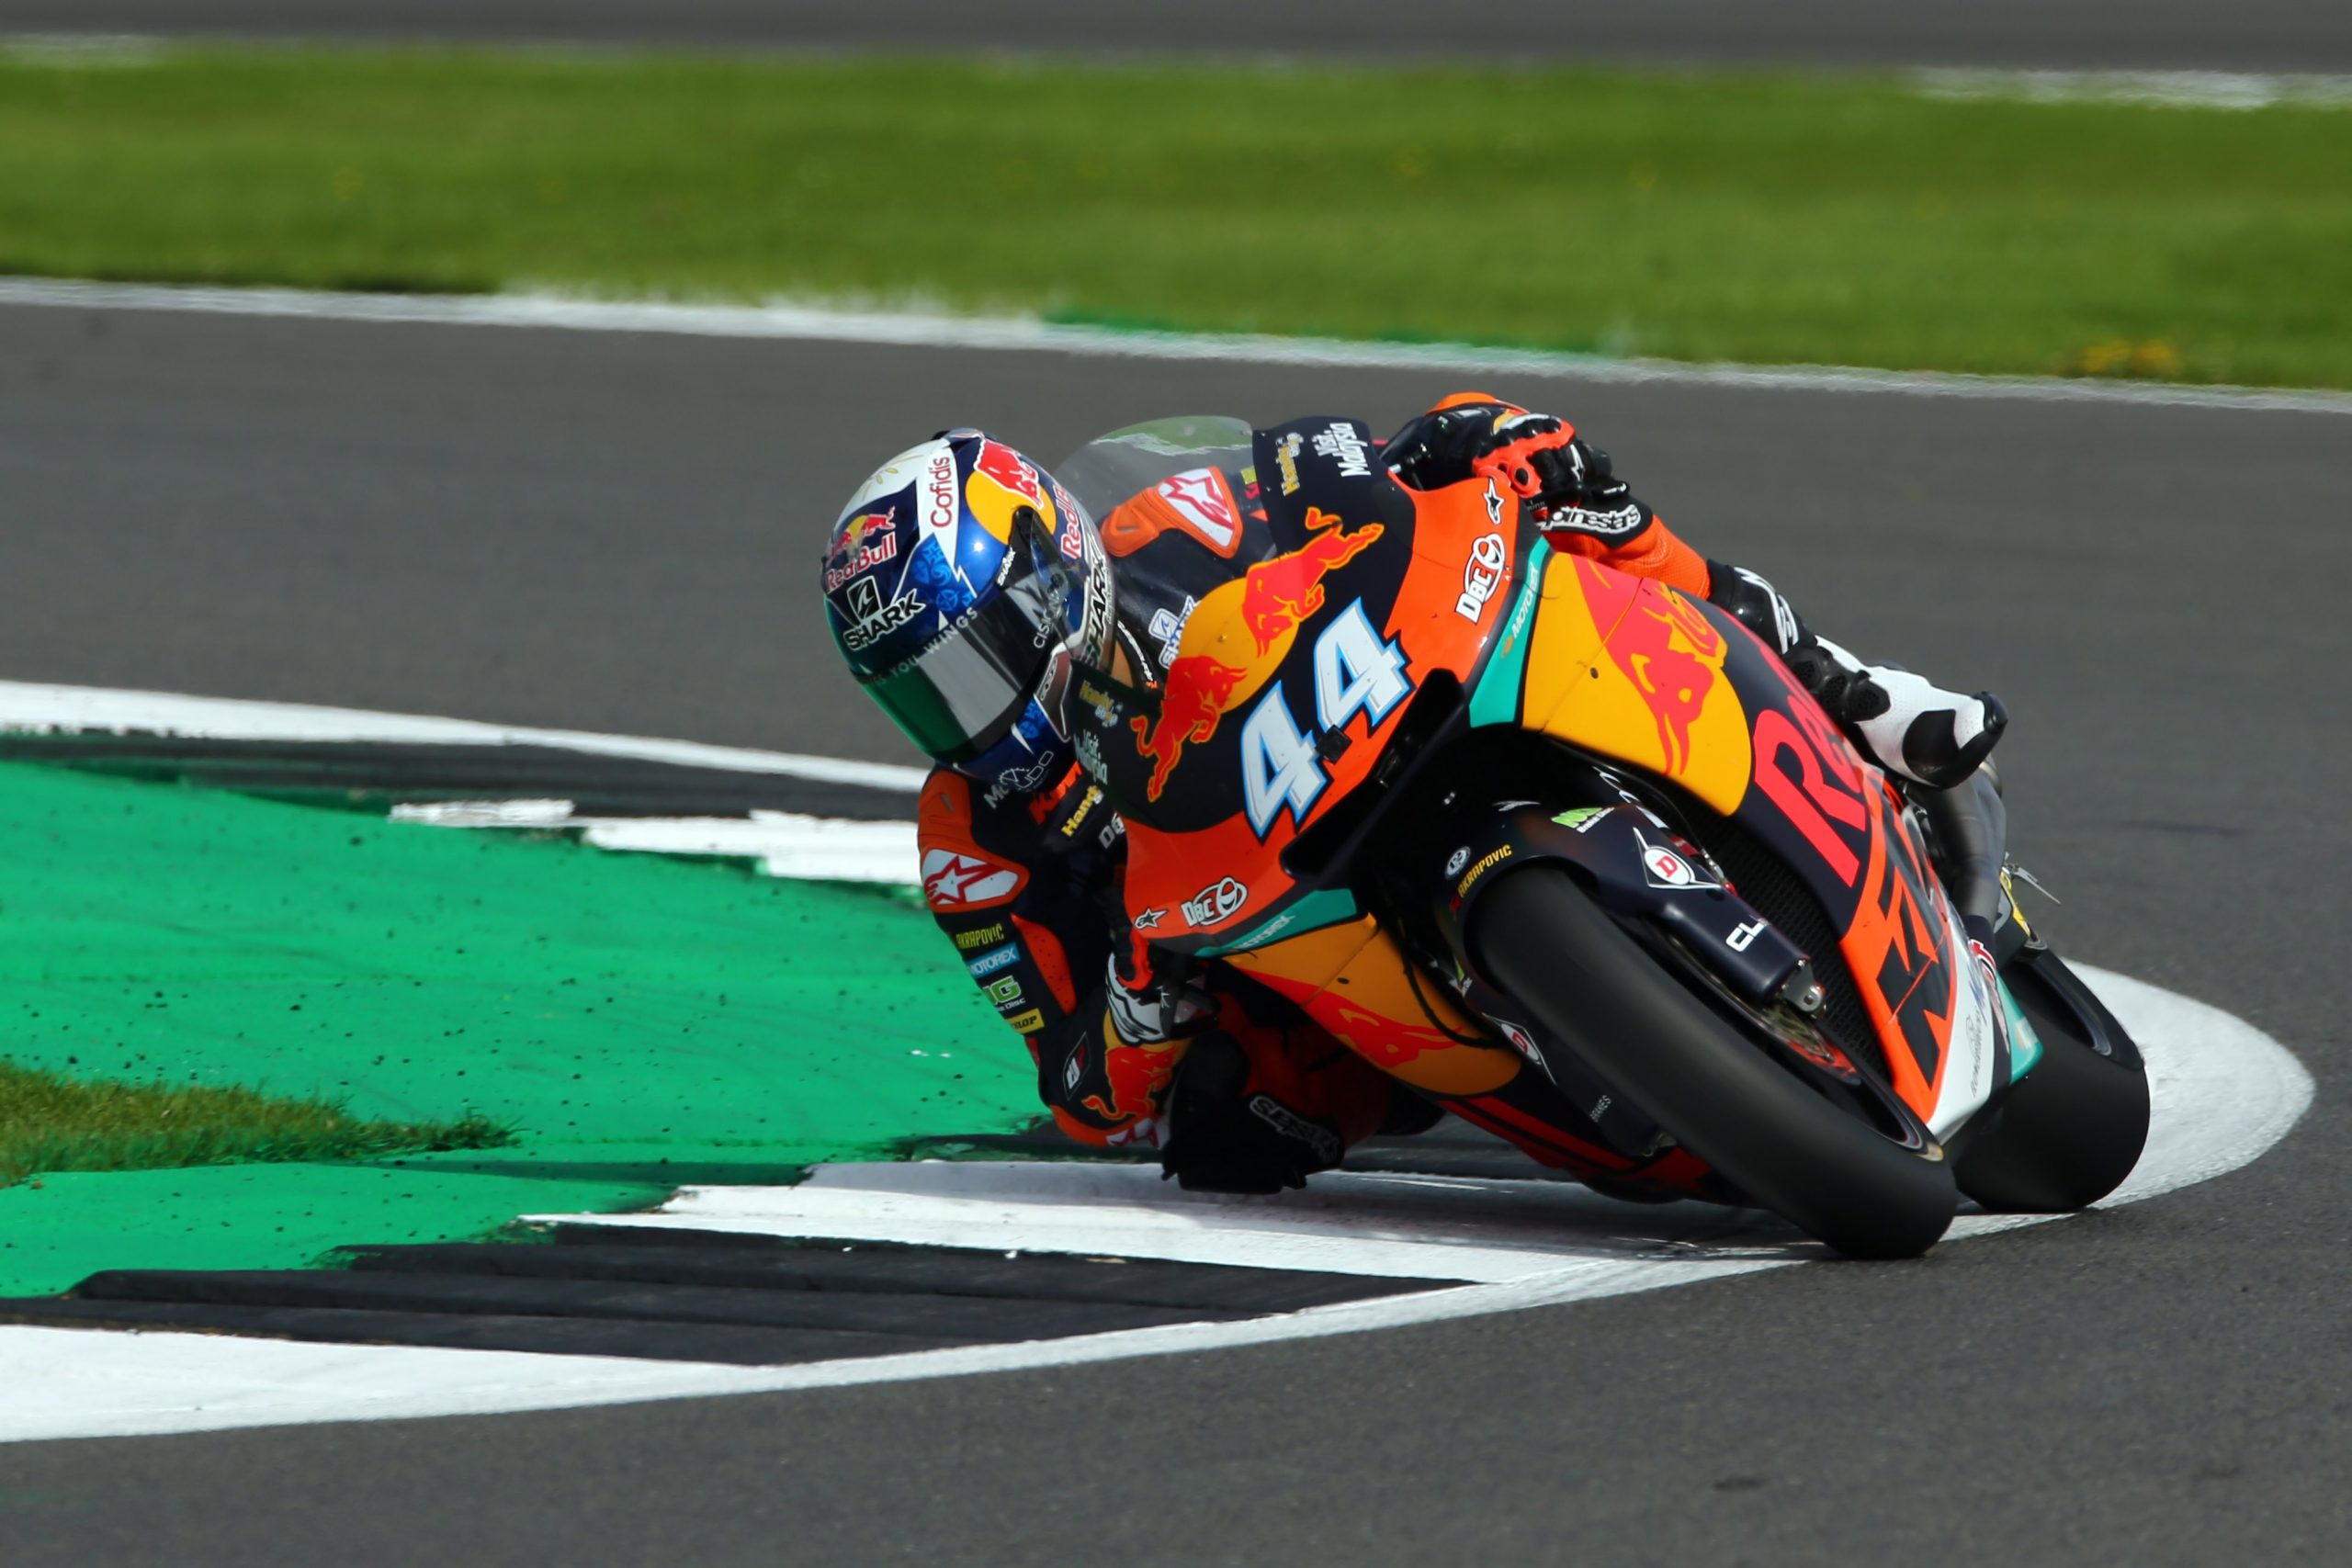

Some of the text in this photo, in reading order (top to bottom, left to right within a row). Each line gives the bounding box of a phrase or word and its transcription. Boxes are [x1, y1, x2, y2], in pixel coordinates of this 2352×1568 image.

[931, 456, 952, 527] Cofidis
[857, 530, 897, 573] Bull
[997, 548, 1017, 587] SHARK
[842, 588, 926, 651] SHARK
[1455, 567, 1494, 625] DBC
[923, 606, 978, 654] WINGS
[1241, 595, 1410, 838] 44
[1061, 785, 1100, 837] Hand
[1099, 816, 1125, 849] DB
[1657, 855, 1679, 878] D
[1181, 897, 1216, 927] DBC
